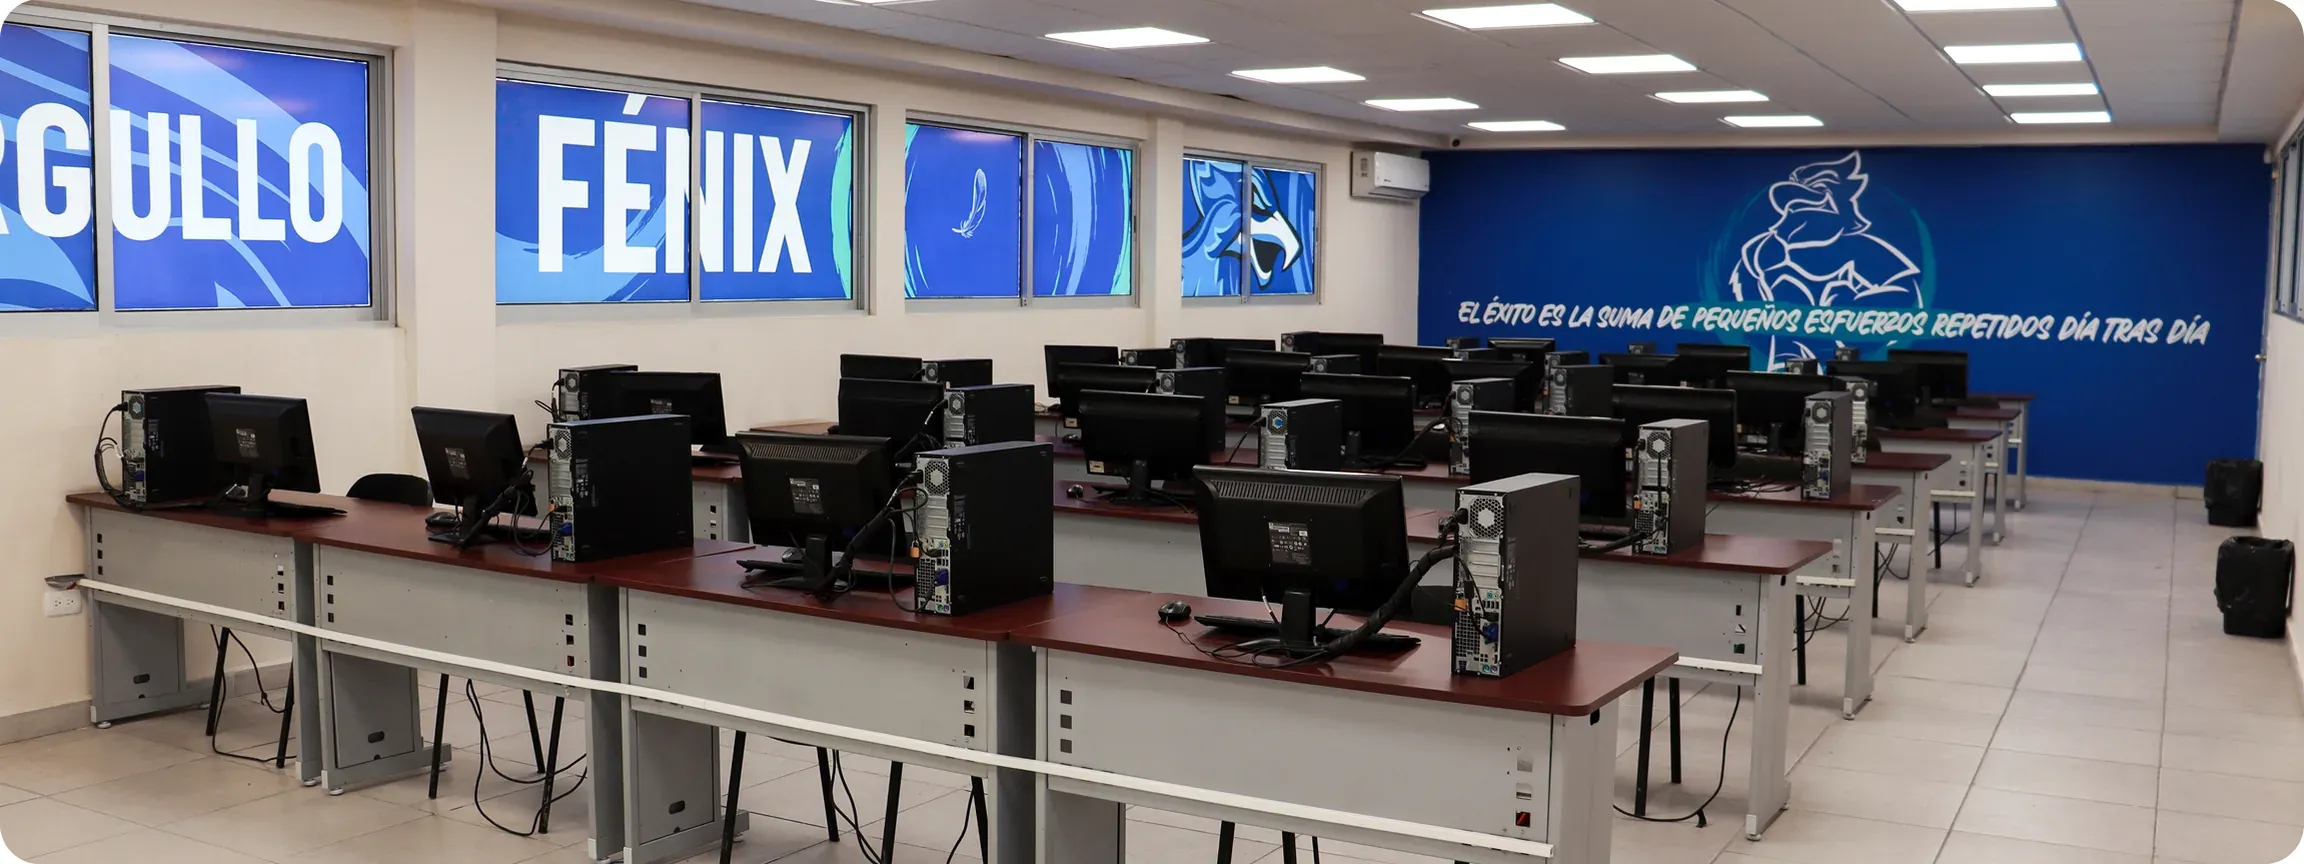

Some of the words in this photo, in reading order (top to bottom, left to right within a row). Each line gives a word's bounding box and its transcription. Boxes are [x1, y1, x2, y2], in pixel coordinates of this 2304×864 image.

[0, 102, 343, 243] GULLO
[538, 93, 812, 274] FÉNIX
[1458, 301, 1481, 324] EL
[1482, 295, 1536, 326] ÉXITO
[1537, 303, 1566, 327] ES
[1568, 305, 1595, 328] LA
[1596, 305, 1655, 330] SUMA
[1656, 305, 1690, 330] DE
[1691, 304, 1802, 333] PEQUEÑOS
[1803, 309, 1929, 336] ESFUERZOS
[1930, 312, 2055, 341] REPETIDOS
[2057, 311, 2100, 341] DÍA
[2102, 317, 2164, 344] TRAS
[2166, 314, 2211, 345] DÍA
